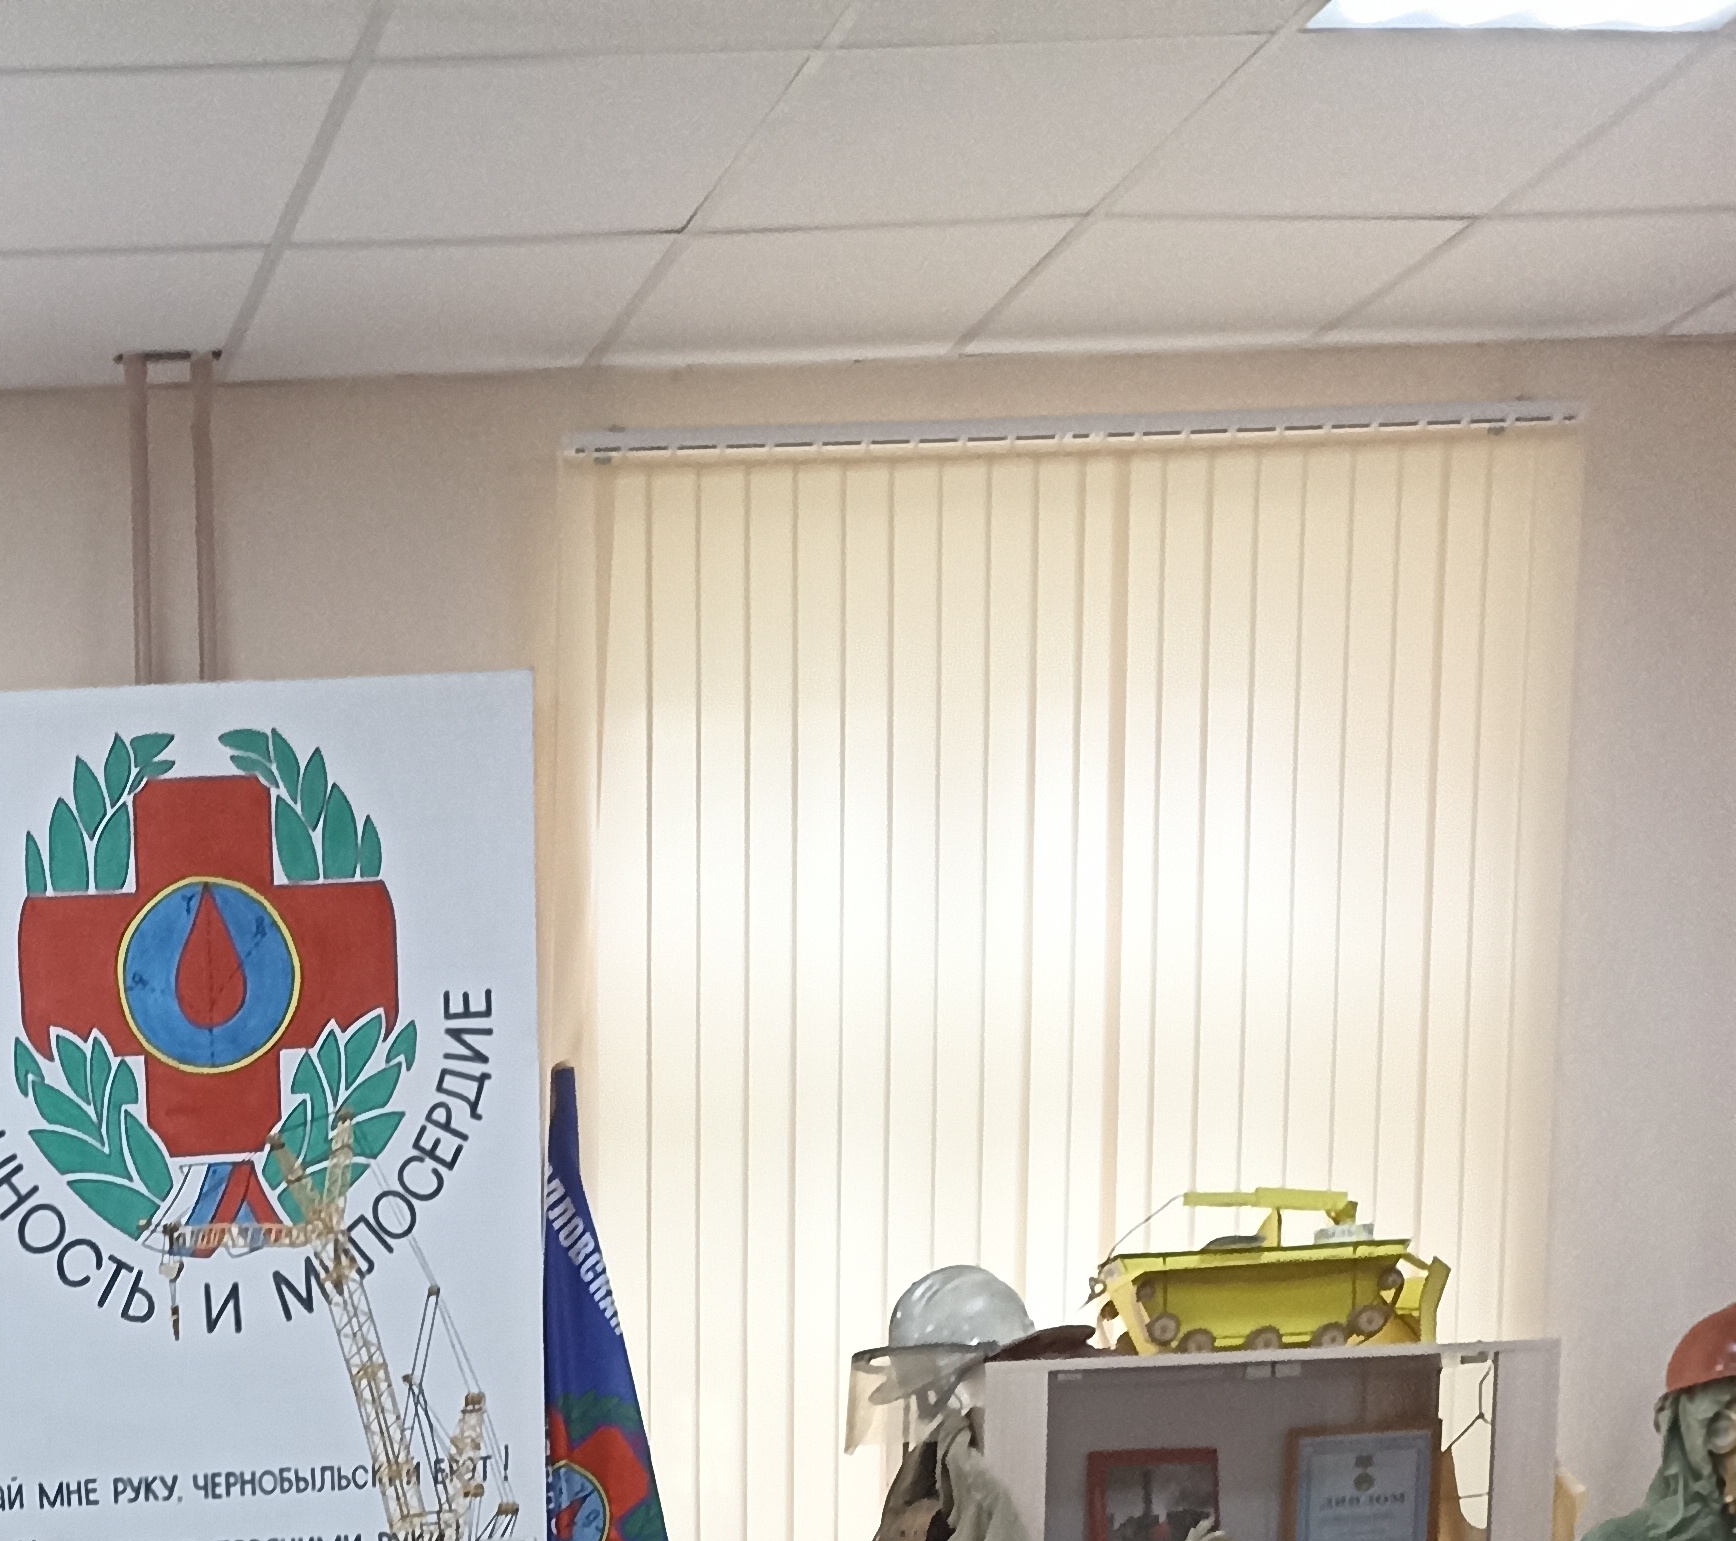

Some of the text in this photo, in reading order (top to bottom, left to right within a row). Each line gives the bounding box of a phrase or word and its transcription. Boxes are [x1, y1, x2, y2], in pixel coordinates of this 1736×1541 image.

[203, 1281, 243, 1334] И
[272, 988, 494, 1320] МЛОСЕРДИЕ
[37, 1477, 100, 1510] МНЕ
